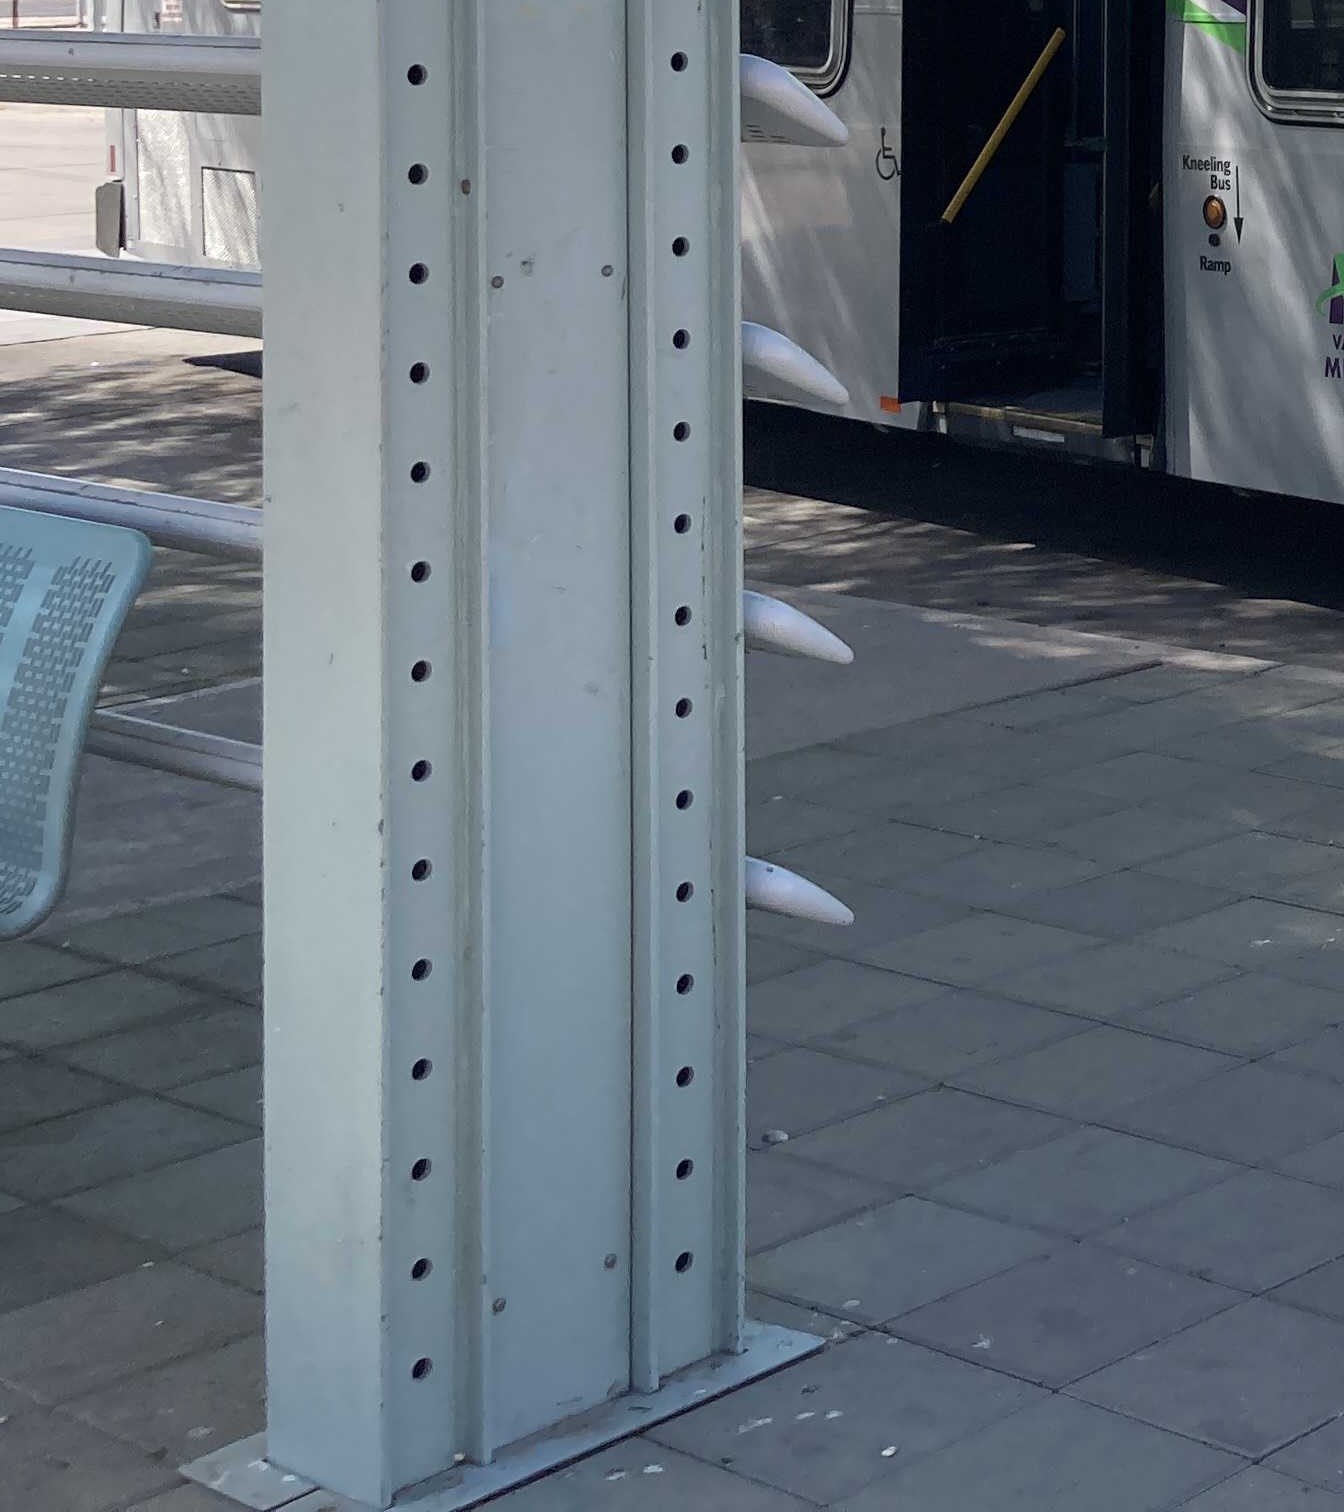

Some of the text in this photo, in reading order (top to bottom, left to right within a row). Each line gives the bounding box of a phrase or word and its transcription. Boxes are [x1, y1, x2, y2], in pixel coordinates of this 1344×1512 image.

[1182, 155, 1231, 176] Kneeling
[1210, 175, 1231, 191] Bus
[1200, 256, 1231, 275] Ramp
